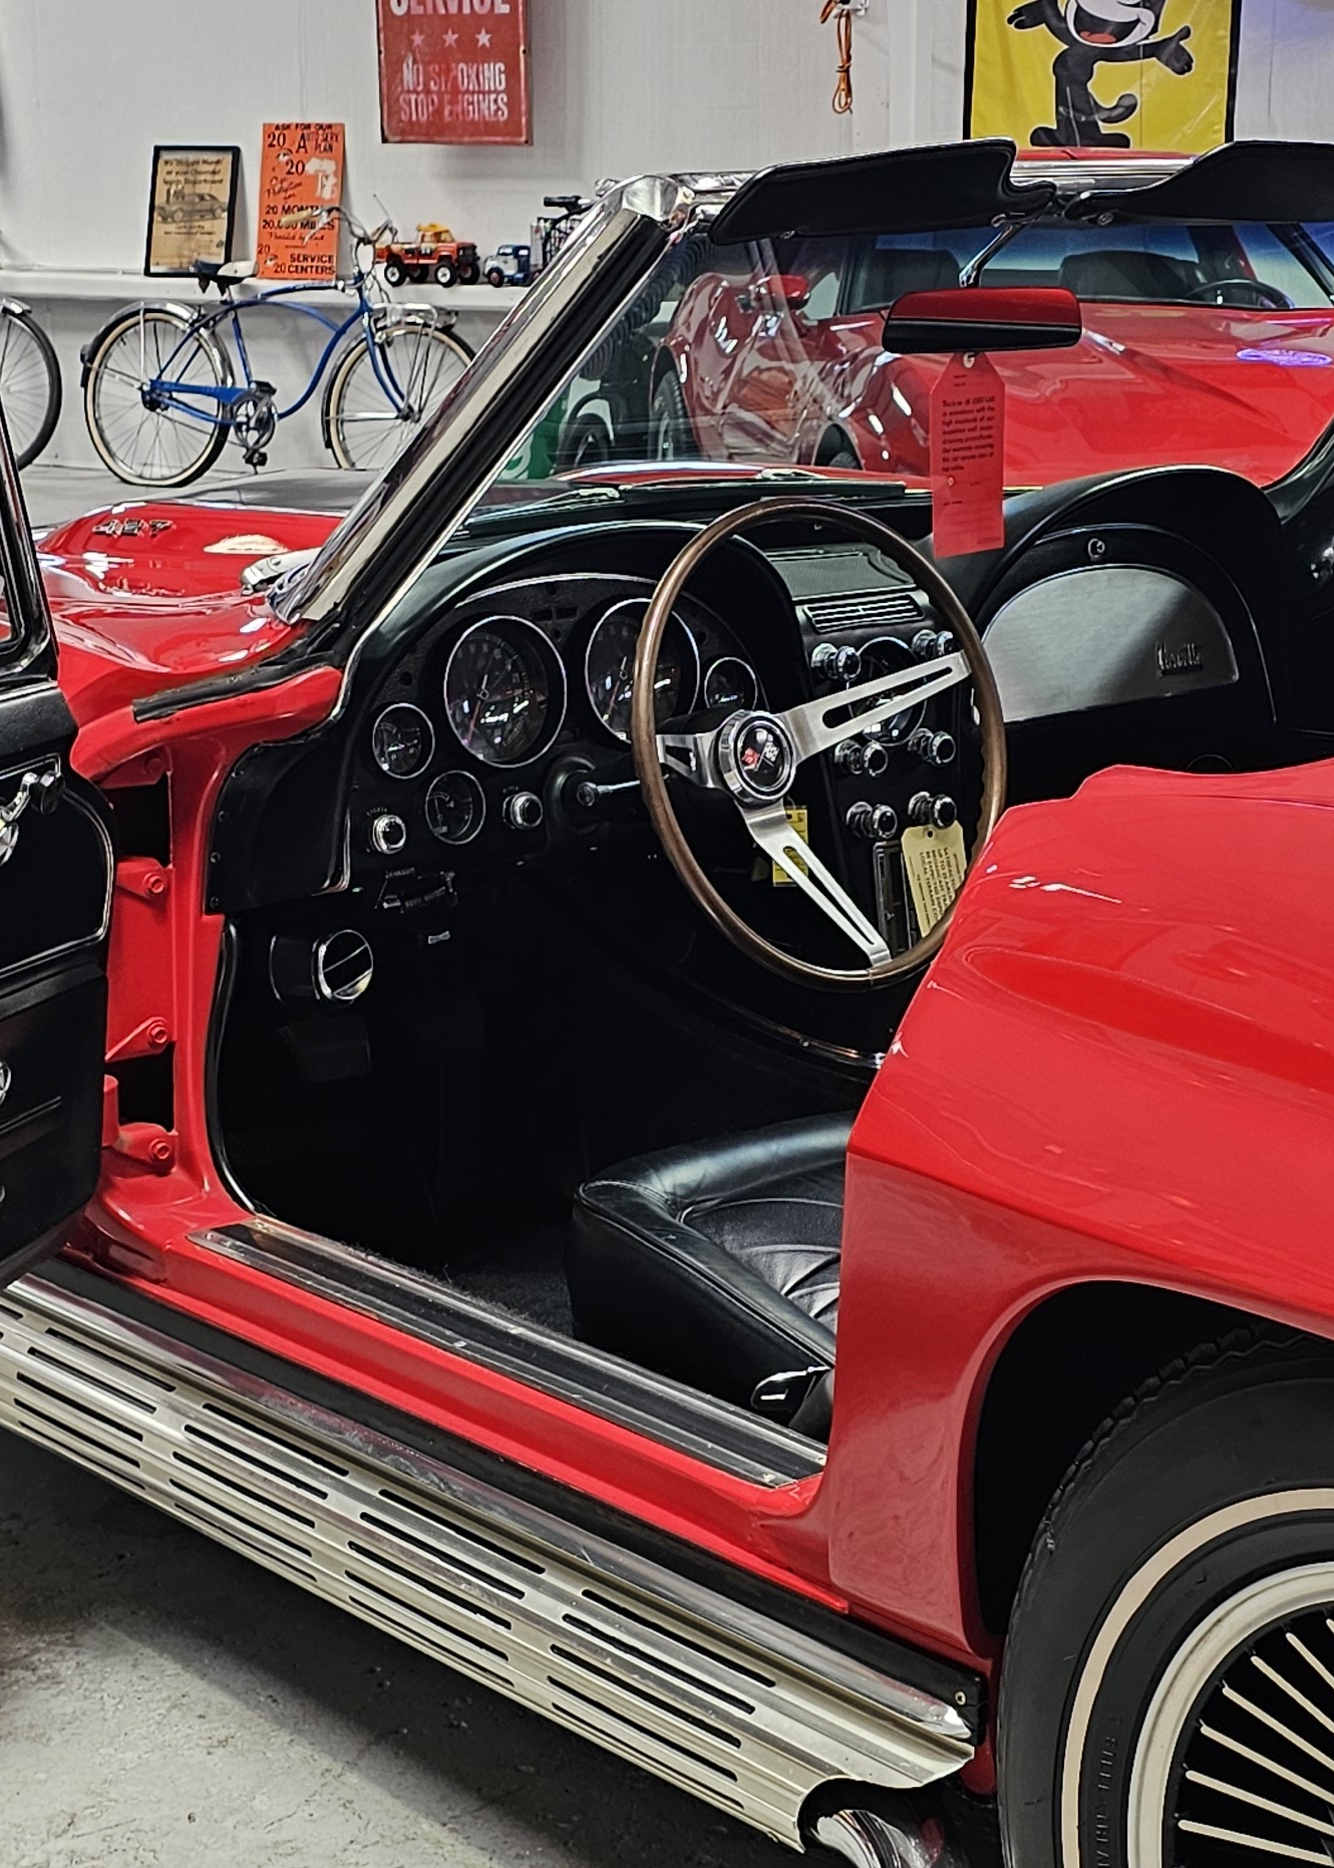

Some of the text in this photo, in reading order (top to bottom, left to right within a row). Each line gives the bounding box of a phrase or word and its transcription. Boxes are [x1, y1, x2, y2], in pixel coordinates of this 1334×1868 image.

[402, 61, 507, 91] NO SMOKING
[399, 93, 508, 122] STOP ENGINES
[295, 123, 312, 131] FOR
[267, 131, 286, 148] 20
[285, 159, 306, 176] 20
[265, 205, 278, 215] 20
[258, 244, 271, 254] 20
[290, 253, 334, 263] SERVICE
[273, 263, 336, 275] 20 CENTERS
